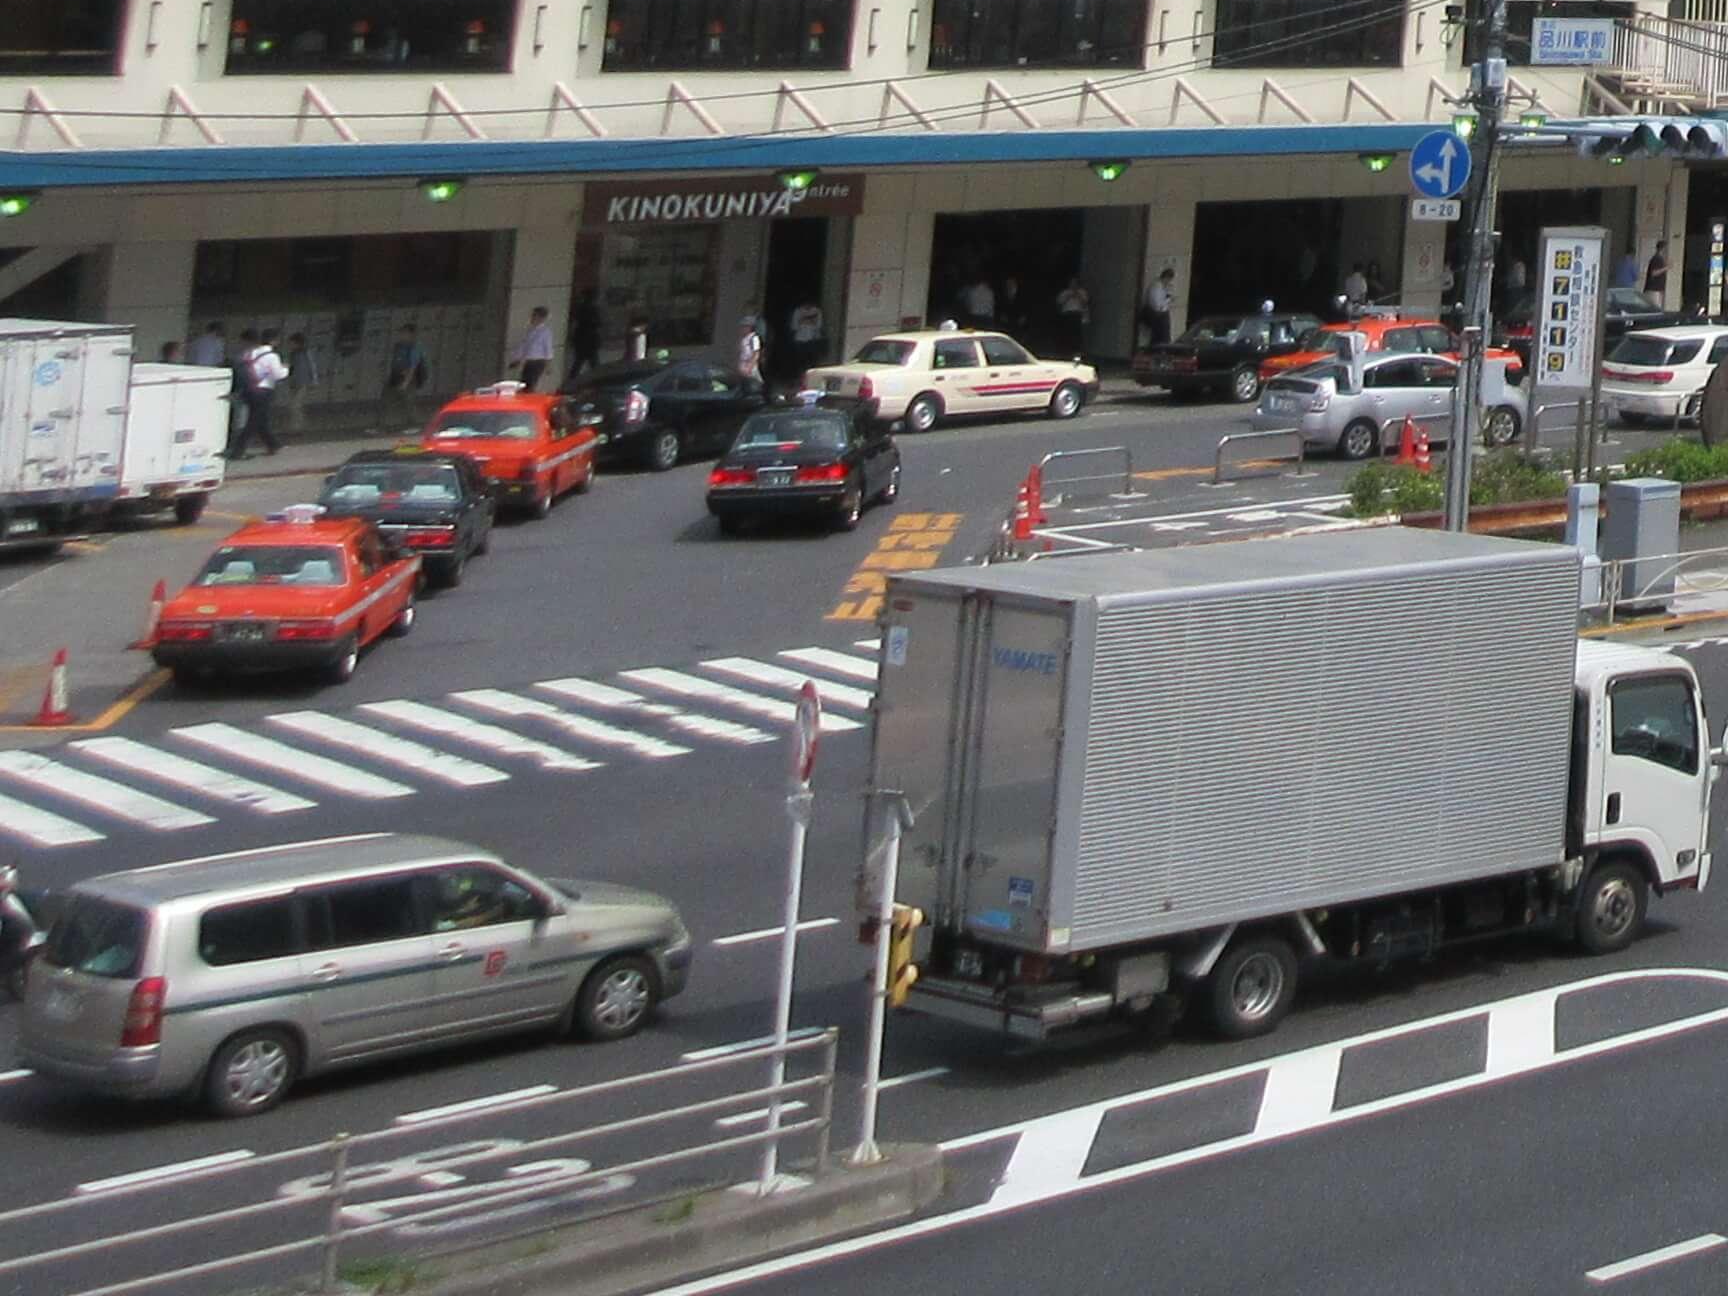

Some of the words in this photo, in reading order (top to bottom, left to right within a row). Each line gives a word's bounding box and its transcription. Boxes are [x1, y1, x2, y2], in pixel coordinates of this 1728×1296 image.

[1539, 30, 1606, 49] 品川駅前
[606, 191, 791, 222] KINOKUNIYA
[993, 647, 1057, 674] YAMATE
